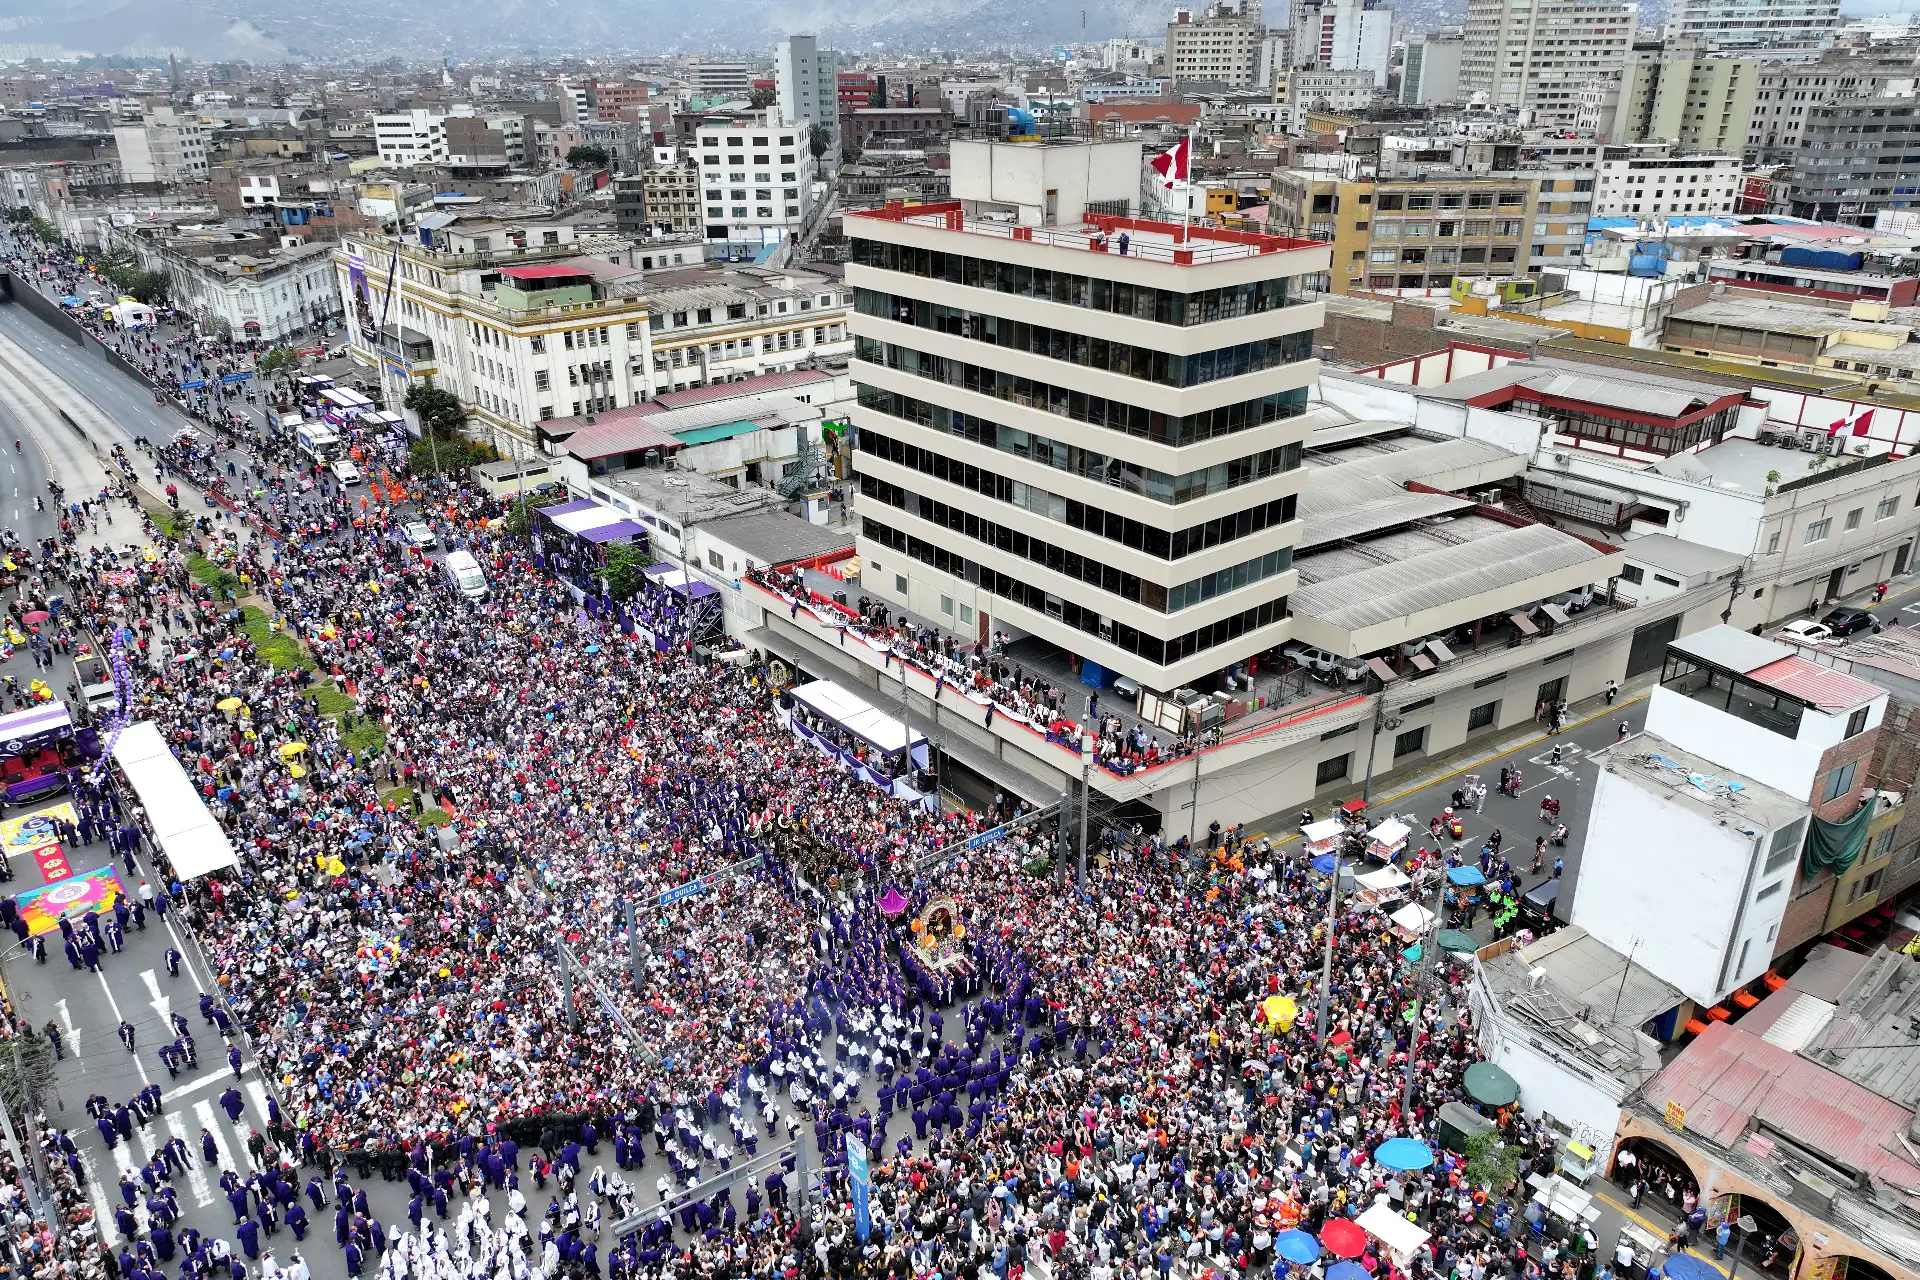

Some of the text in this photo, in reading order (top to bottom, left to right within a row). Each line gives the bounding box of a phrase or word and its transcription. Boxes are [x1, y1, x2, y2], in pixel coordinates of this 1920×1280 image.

[972, 830, 1001, 847] JR. QUILCA
[663, 884, 698, 903] JR. QUILCA
